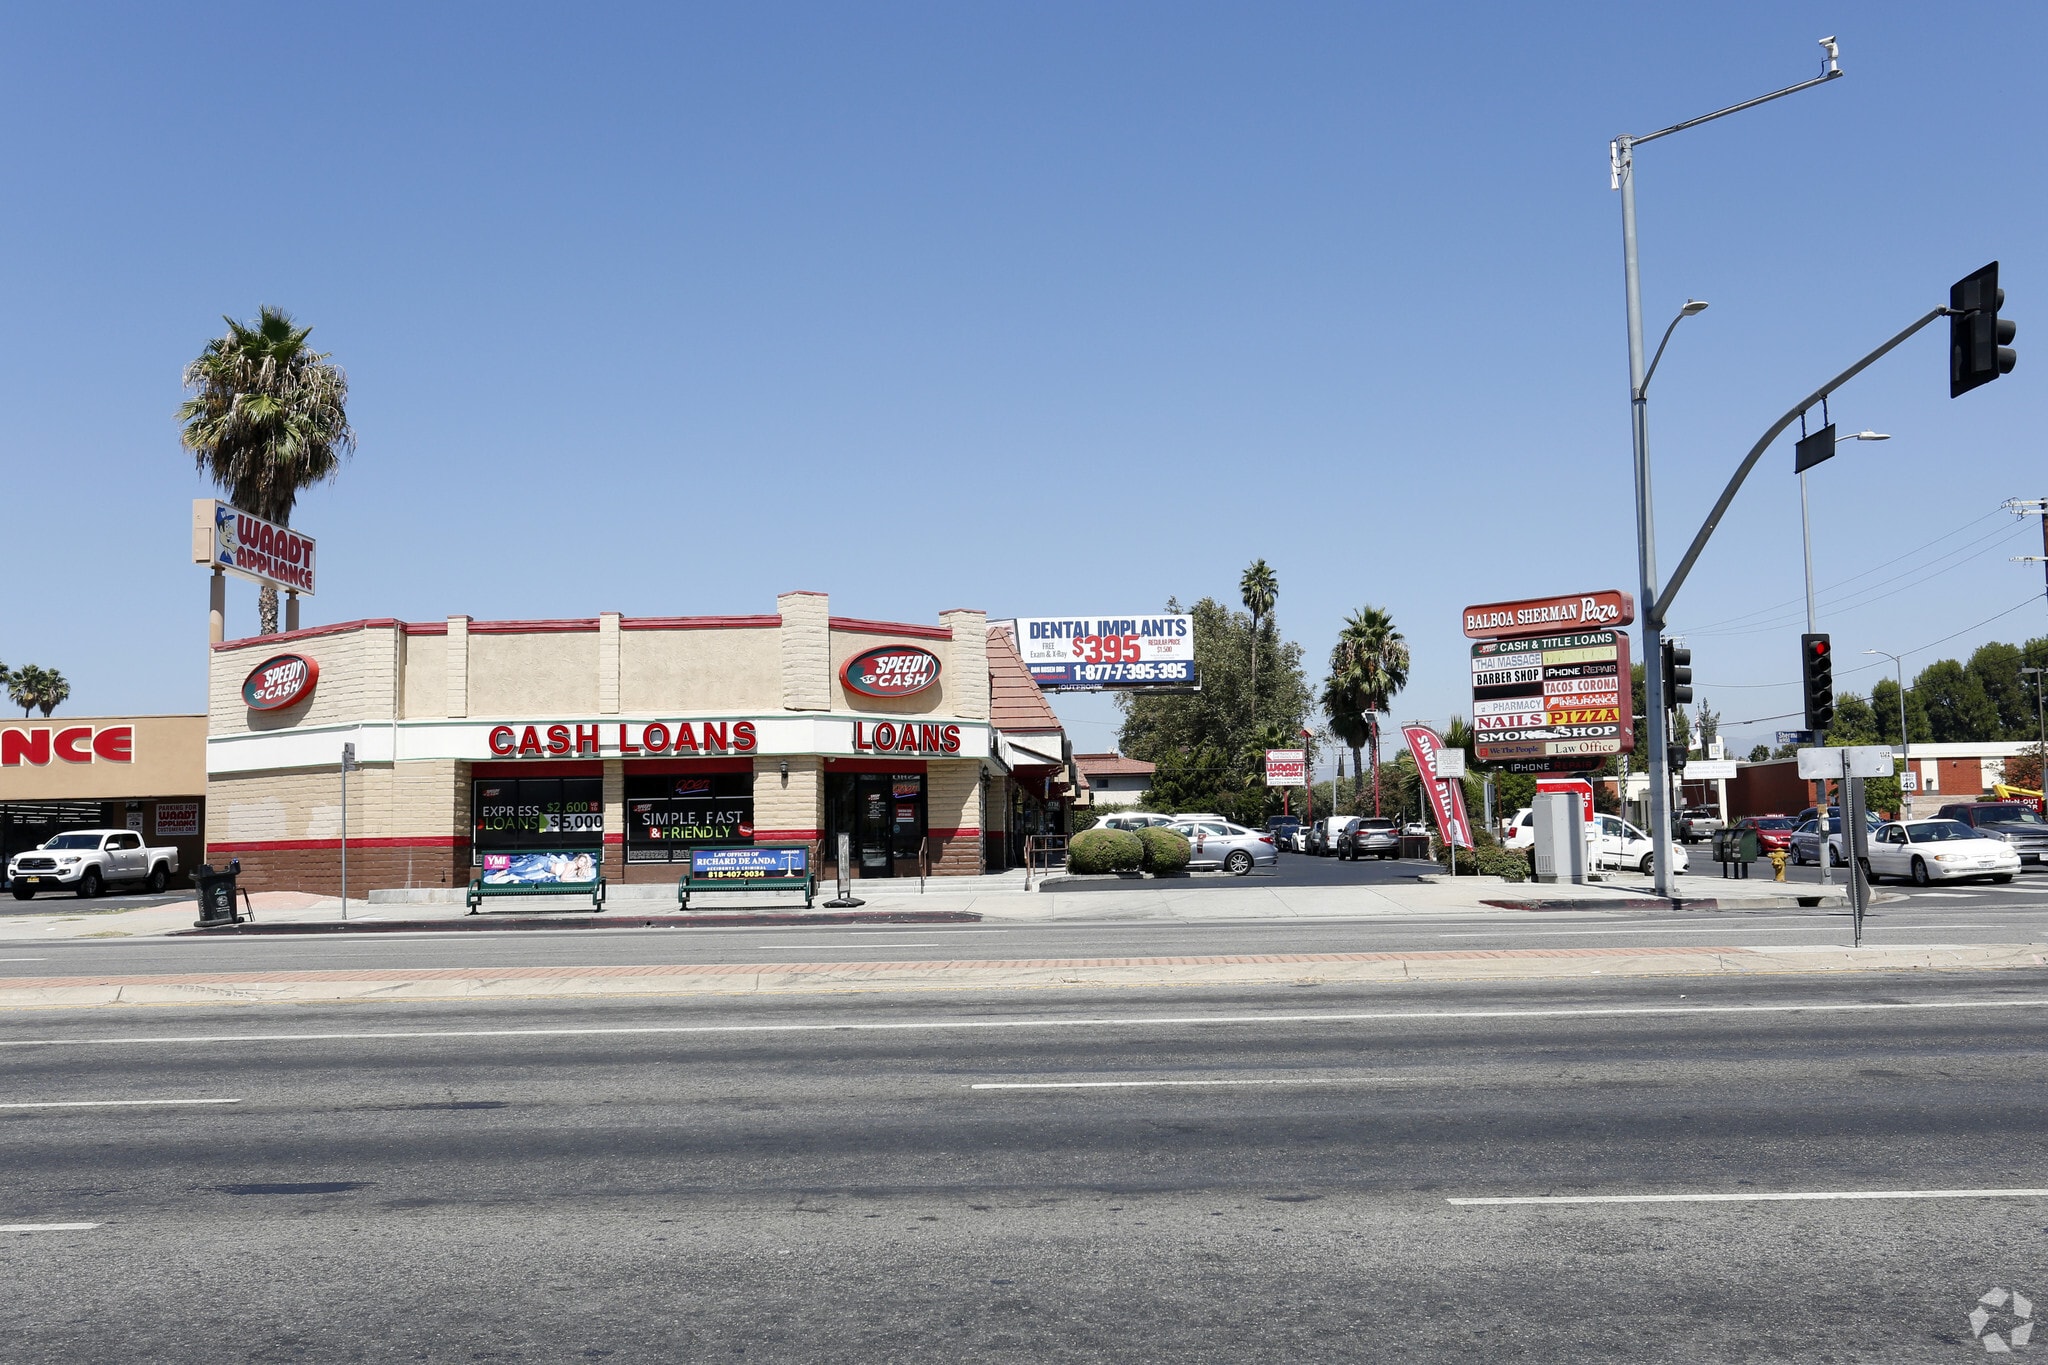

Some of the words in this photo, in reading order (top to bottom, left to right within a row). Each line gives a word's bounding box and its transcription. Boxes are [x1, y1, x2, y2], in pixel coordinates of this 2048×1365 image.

[237, 514, 313, 568] WAADT
[236, 546, 313, 590] APPLIANCE
[1467, 611, 1514, 630] BALBOA
[1517, 604, 1578, 628] SHERMAN
[1580, 597, 1619, 623] Plaza
[1029, 620, 1090, 639] DENTAL
[1097, 618, 1187, 638] IMPLANTS
[1042, 642, 1055, 650] FREE
[1072, 634, 1141, 664] $395
[1500, 641, 1531, 653] CASH
[1532, 640, 1539, 649] &
[1541, 636, 1571, 648] TITLE
[1575, 633, 1613, 645] LOANS
[1030, 650, 1045, 658] Exam
[1045, 650, 1051, 658] &
[1052, 650, 1067, 659] X-Ray
[1476, 658, 1496, 670] THAI
[1497, 653, 1541, 668] MASSAGE
[873, 655, 932, 674] SPEEDY
[1074, 662, 1187, 681] 1-877-7-395-395
[263, 660, 304, 687] SPEEDY
[1477, 671, 1513, 685] BARBER
[1514, 668, 1539, 682] SHOP
[1545, 682, 1574, 693] TACOS
[1577, 678, 1618, 691] CORONA
[1493, 699, 1542, 711] PHARMACY
[1560, 697, 1618, 706] INSURANCE
[1478, 713, 1543, 729] NAILS
[1551, 709, 1618, 724] PIZZA
[488, 724, 600, 755] CASH
[619, 721, 757, 753] LOANS
[855, 721, 961, 753] LOANS
[1559, 726, 1617, 738] SHOP
[0, 726, 134, 766] NCE
[1502, 746, 1515, 754] The
[1516, 746, 1539, 754] People
[1555, 743, 1577, 754] Law
[1580, 741, 1614, 752] Office
[1417, 735, 1437, 780] OANS
[1903, 781, 1915, 789] 40
[547, 802, 588, 813] $2,600
[1435, 782, 1451, 819] TITLE
[158, 811, 197, 820] WAADT
[482, 805, 540, 817] EXPRESS
[642, 811, 700, 826] SIMPLE,
[706, 810, 743, 825] FAST
[485, 816, 538, 830] LOANS
[550, 814, 603, 830] $5,000
[697, 858, 738, 866] RICHARD
[751, 857, 777, 865] ANDA
